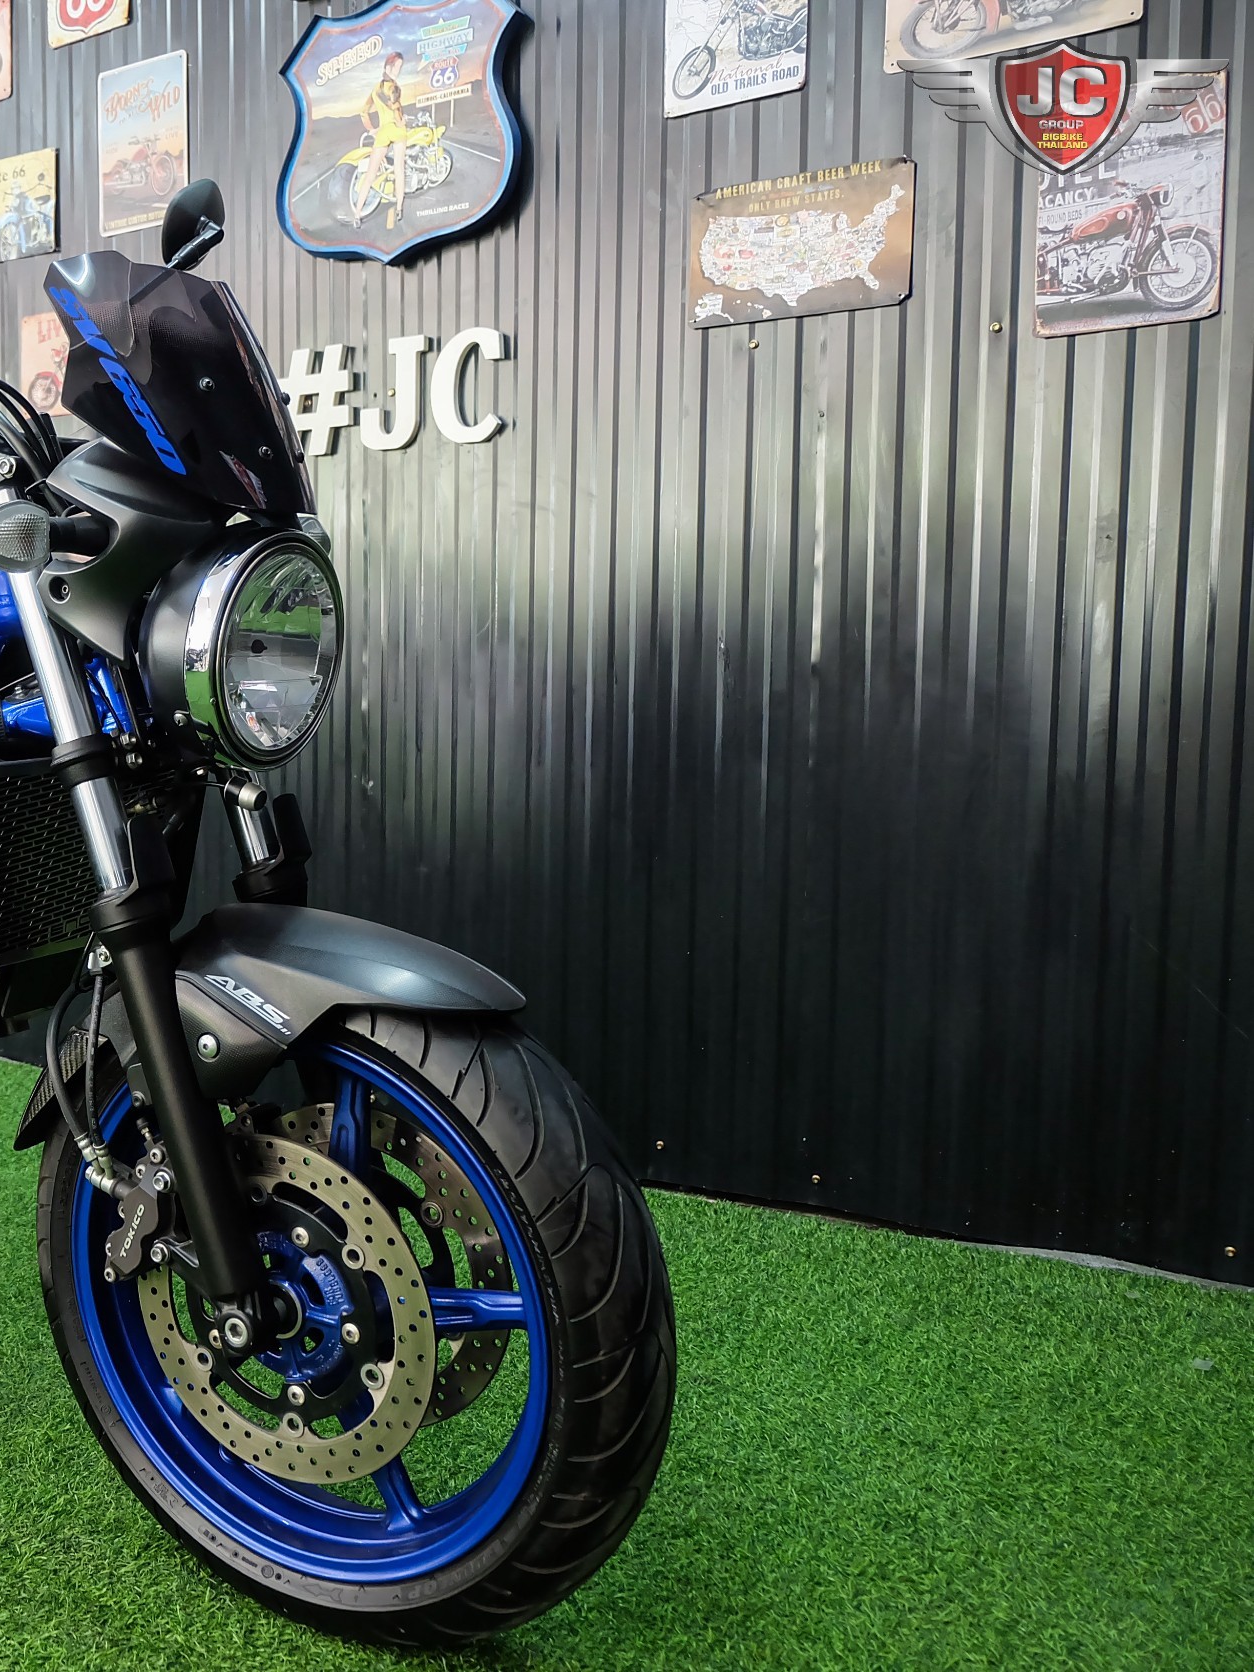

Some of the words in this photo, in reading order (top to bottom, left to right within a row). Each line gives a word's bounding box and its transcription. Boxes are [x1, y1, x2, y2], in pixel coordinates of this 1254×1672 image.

[420, 31, 469, 50] HIGHWAY
[316, 34, 383, 86] SPEED
[709, 51, 784, 84] National
[432, 67, 455, 87] 66
[711, 82, 728, 95] OLD
[734, 73, 767, 90] TRAILS
[772, 65, 800, 82] ROAD
[1186, 93, 1221, 134] 66
[12, 165, 26, 179] 66
[716, 180, 772, 200] AMERICAN
[777, 172, 812, 189] CRAFT
[818, 167, 844, 182] BEER
[850, 160, 882, 176] WEEK
[417, 206, 448, 217] THRILLING
[449, 202, 469, 211] RACES
[748, 200, 771, 213] ONLY
[775, 196, 800, 209] BREW
[279, 327, 506, 456] #JC
[205, 974, 291, 1024] ABS
[119, 1204, 145, 1257] TOKICO
